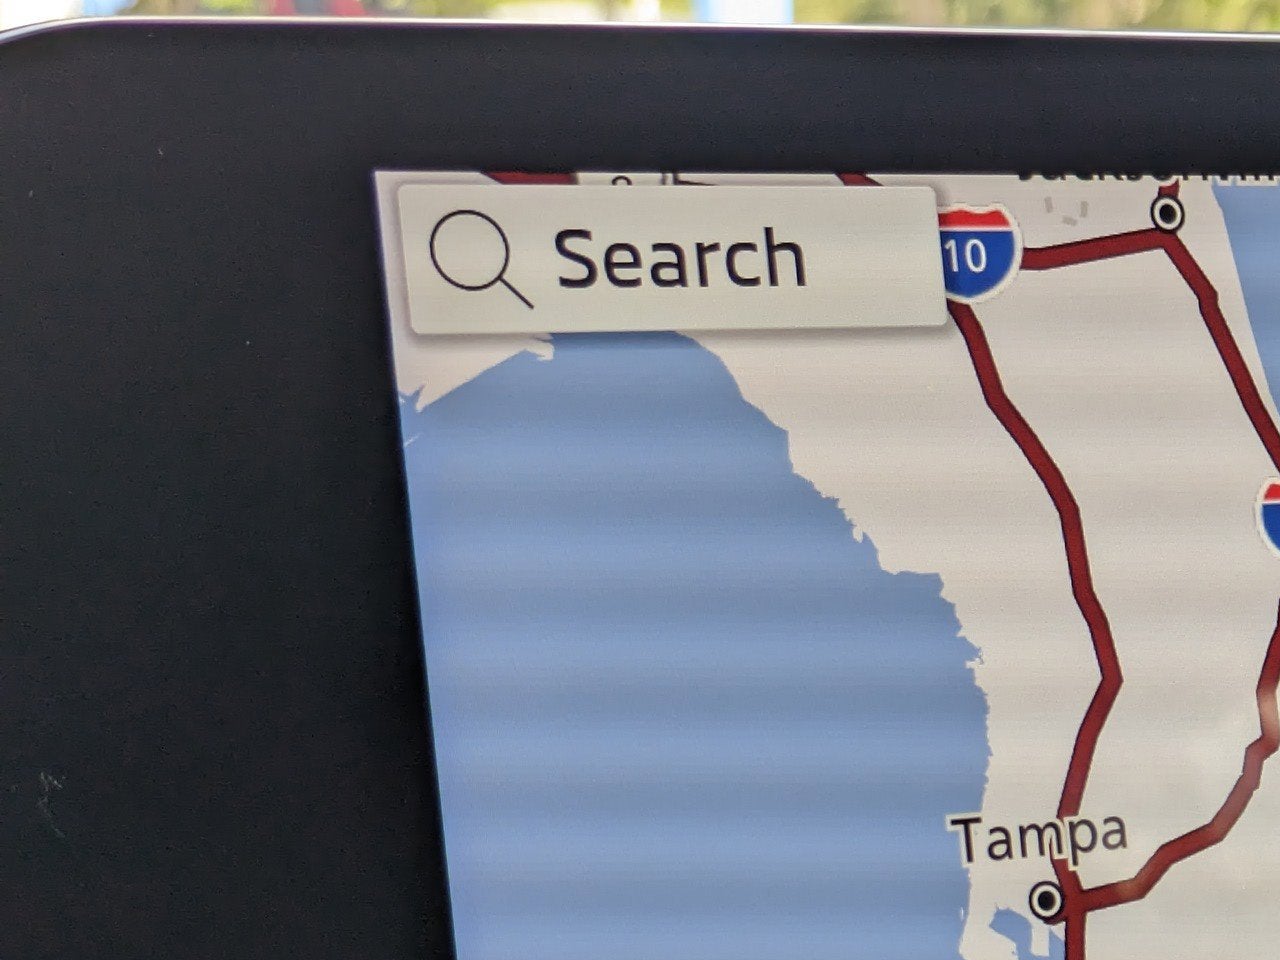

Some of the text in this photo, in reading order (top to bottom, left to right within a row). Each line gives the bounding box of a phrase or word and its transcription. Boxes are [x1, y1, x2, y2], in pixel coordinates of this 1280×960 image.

[555, 227, 807, 289] Search
[944, 239, 986, 273] 10
[951, 814, 1128, 865] Tampa
